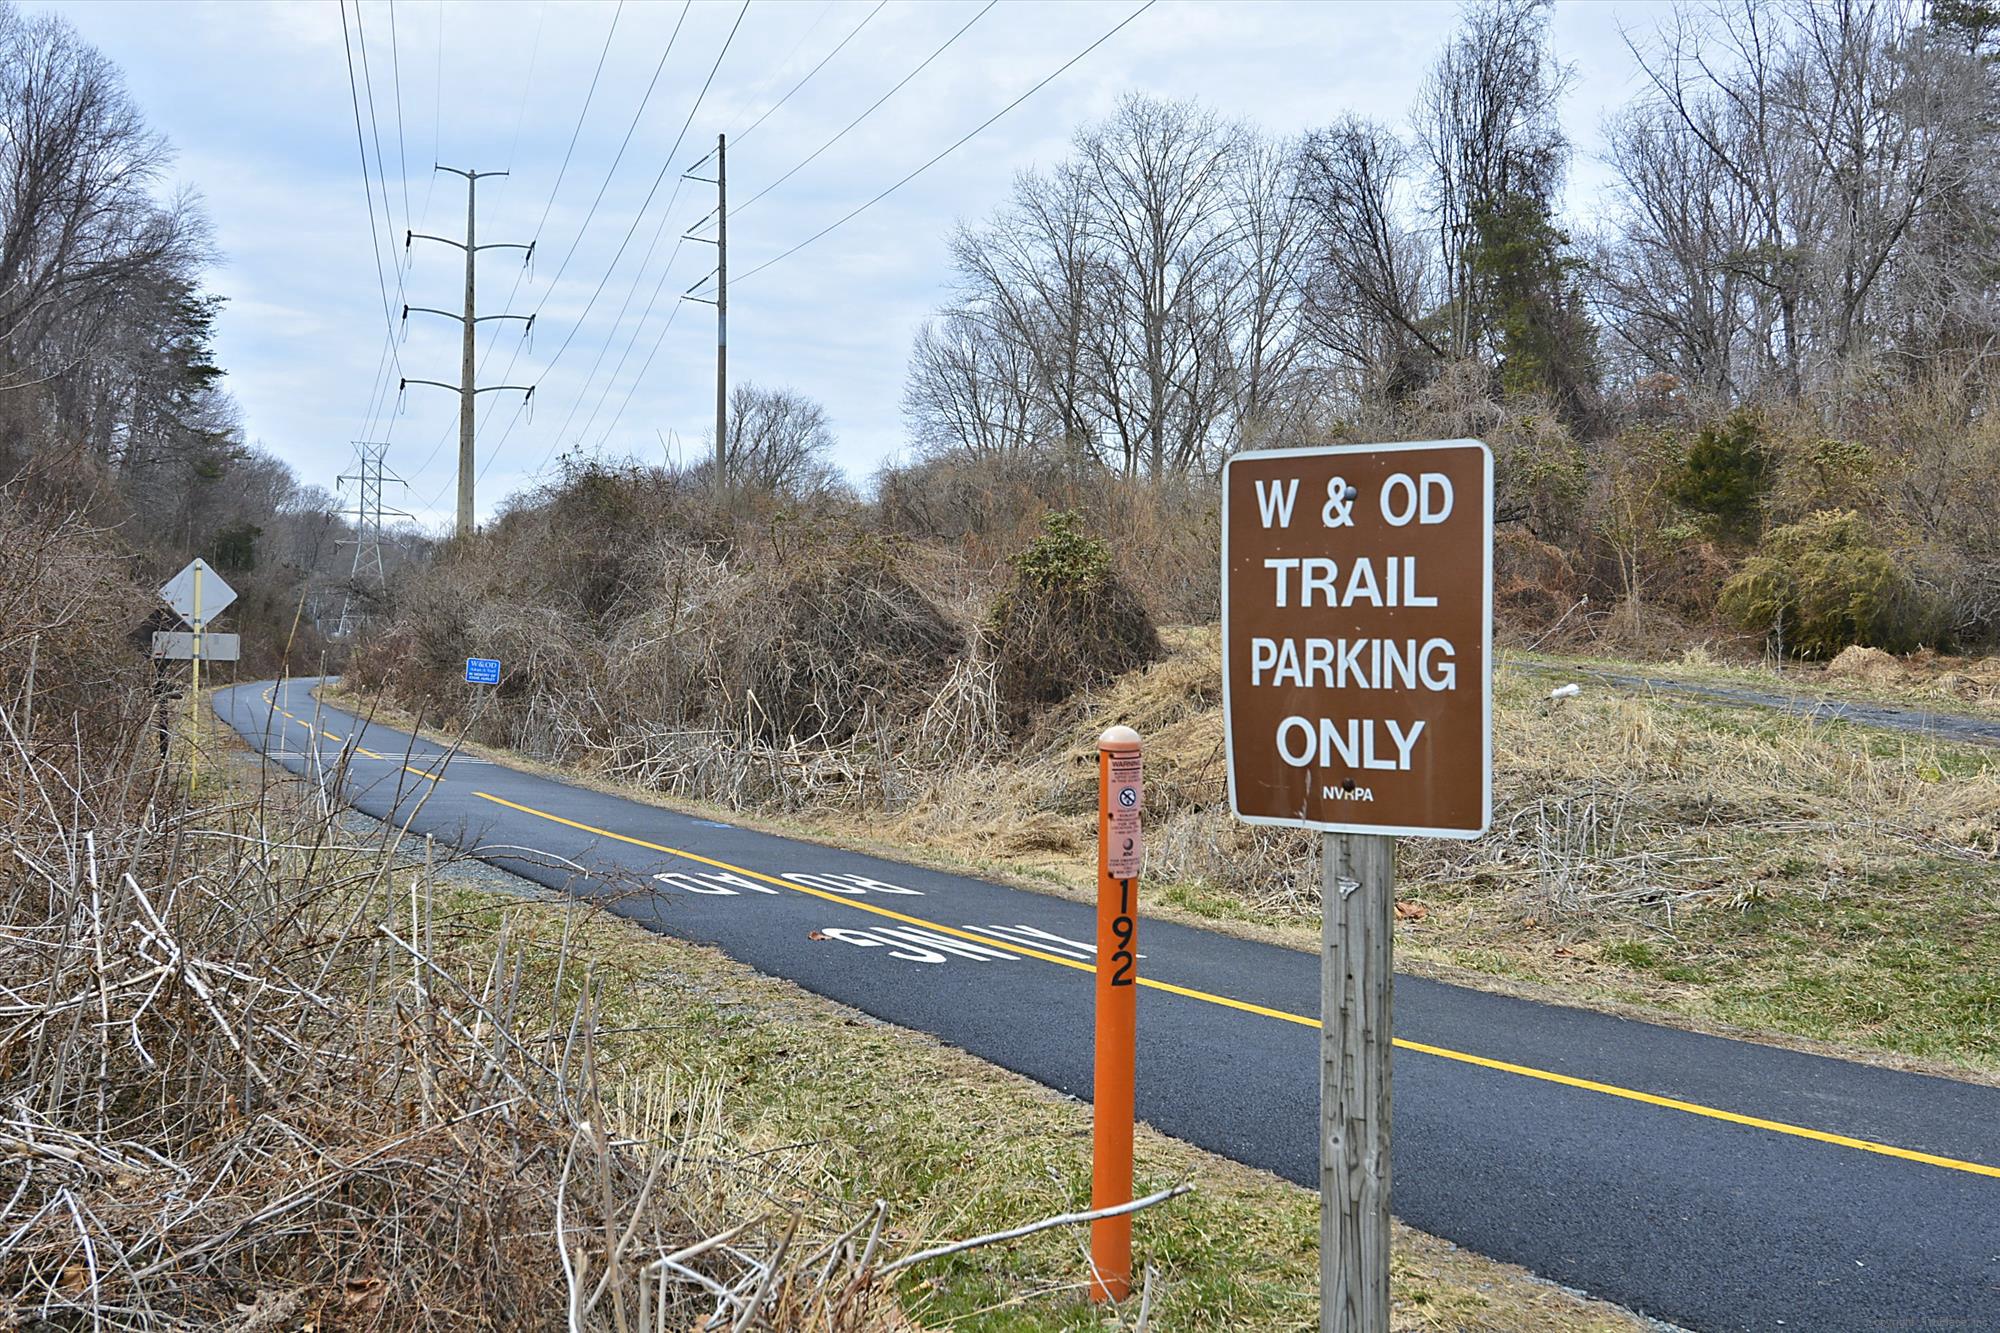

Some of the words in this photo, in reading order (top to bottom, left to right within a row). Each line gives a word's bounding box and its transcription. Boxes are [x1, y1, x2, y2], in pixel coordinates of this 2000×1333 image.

[1255, 478, 1299, 528] W
[1322, 476, 1355, 528] &
[1380, 472, 1454, 527] OD
[1264, 556, 1438, 608] TRAIL
[1251, 637, 1456, 691] PARKING
[1275, 715, 1426, 771] ONLY
[1323, 786, 1374, 802] NVRPA
